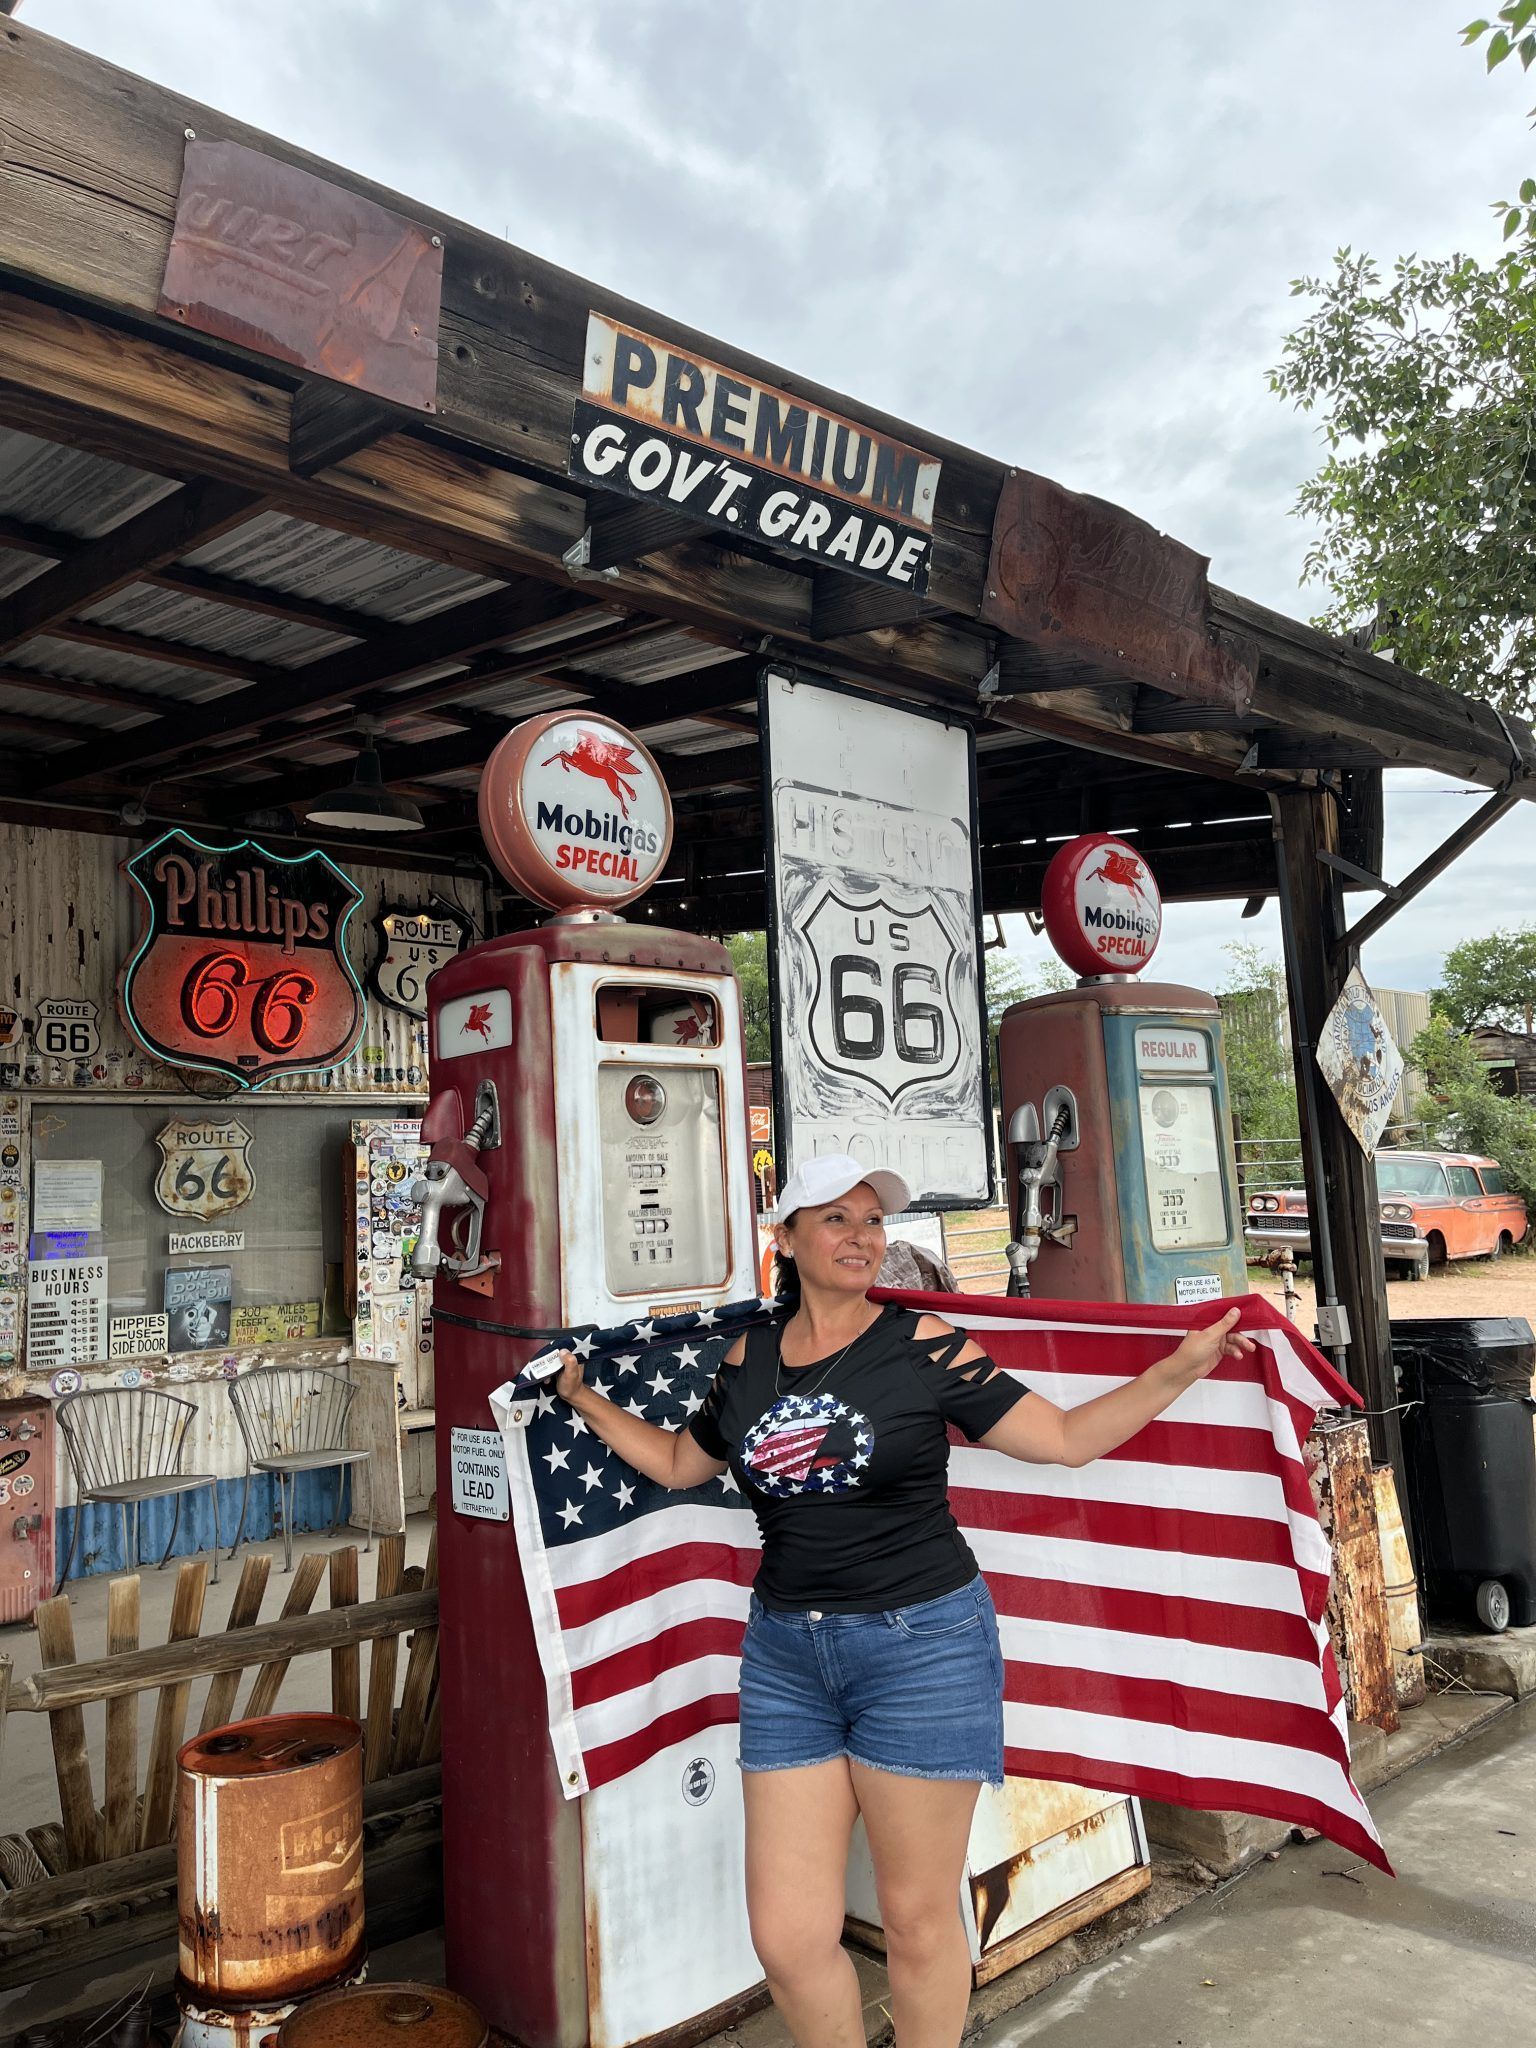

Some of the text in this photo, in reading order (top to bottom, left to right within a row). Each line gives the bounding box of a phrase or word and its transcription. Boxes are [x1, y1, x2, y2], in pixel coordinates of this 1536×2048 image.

[611, 331, 920, 517] PREMIUM
[582, 424, 927, 582] GOV'T. GRADE
[536, 801, 658, 856] Mobilgas
[555, 844, 640, 882] SPECIAL
[154, 854, 330, 955] Phillips
[393, 919, 453, 942] ROUTE
[1084, 906, 1157, 939] Mobilgas
[854, 917, 910, 952] US
[1097, 935, 1148, 957] SPECIAL
[396, 964, 444, 1002] 6
[47, 1004, 89, 1017] ROUTE
[180, 951, 319, 1055] 66
[830, 954, 945, 1064] 66
[46, 1022, 90, 1053] 66
[1141, 1040, 1198, 1059] REGULAR
[1380, 1068, 1400, 1109] ANGELES
[176, 1131, 236, 1145] ROUTE
[176, 1155, 239, 1201] 66
[171, 1233, 243, 1250] HACKBERRY
[32, 1266, 103, 1282] BUSINESS
[184, 1270, 211, 1281] WE
[45, 1281, 89, 1296] HOURS
[174, 1278, 221, 1295] DON'T
[208, 1286, 229, 1298] 911
[1179, 1286, 1221, 1296] MOTOR FUEL ONLY
[240, 1304, 305, 1318] 300 MILES
[113, 1316, 165, 1330] HIPPIES
[236, 1314, 308, 1327] DESERT AHEAD
[128, 1329, 151, 1340] USE
[235, 1324, 306, 1339] WATER ICE
[112, 1338, 166, 1355] SIDE DOOR
[237, 1336, 256, 1345] BAGS
[457, 1433, 498, 1445] FOR USE AS A
[453, 1445, 505, 1459] MOTOR FUEL ONLY
[457, 1461, 500, 1478] CONTAINS
[462, 1479, 495, 1500] LEAD
